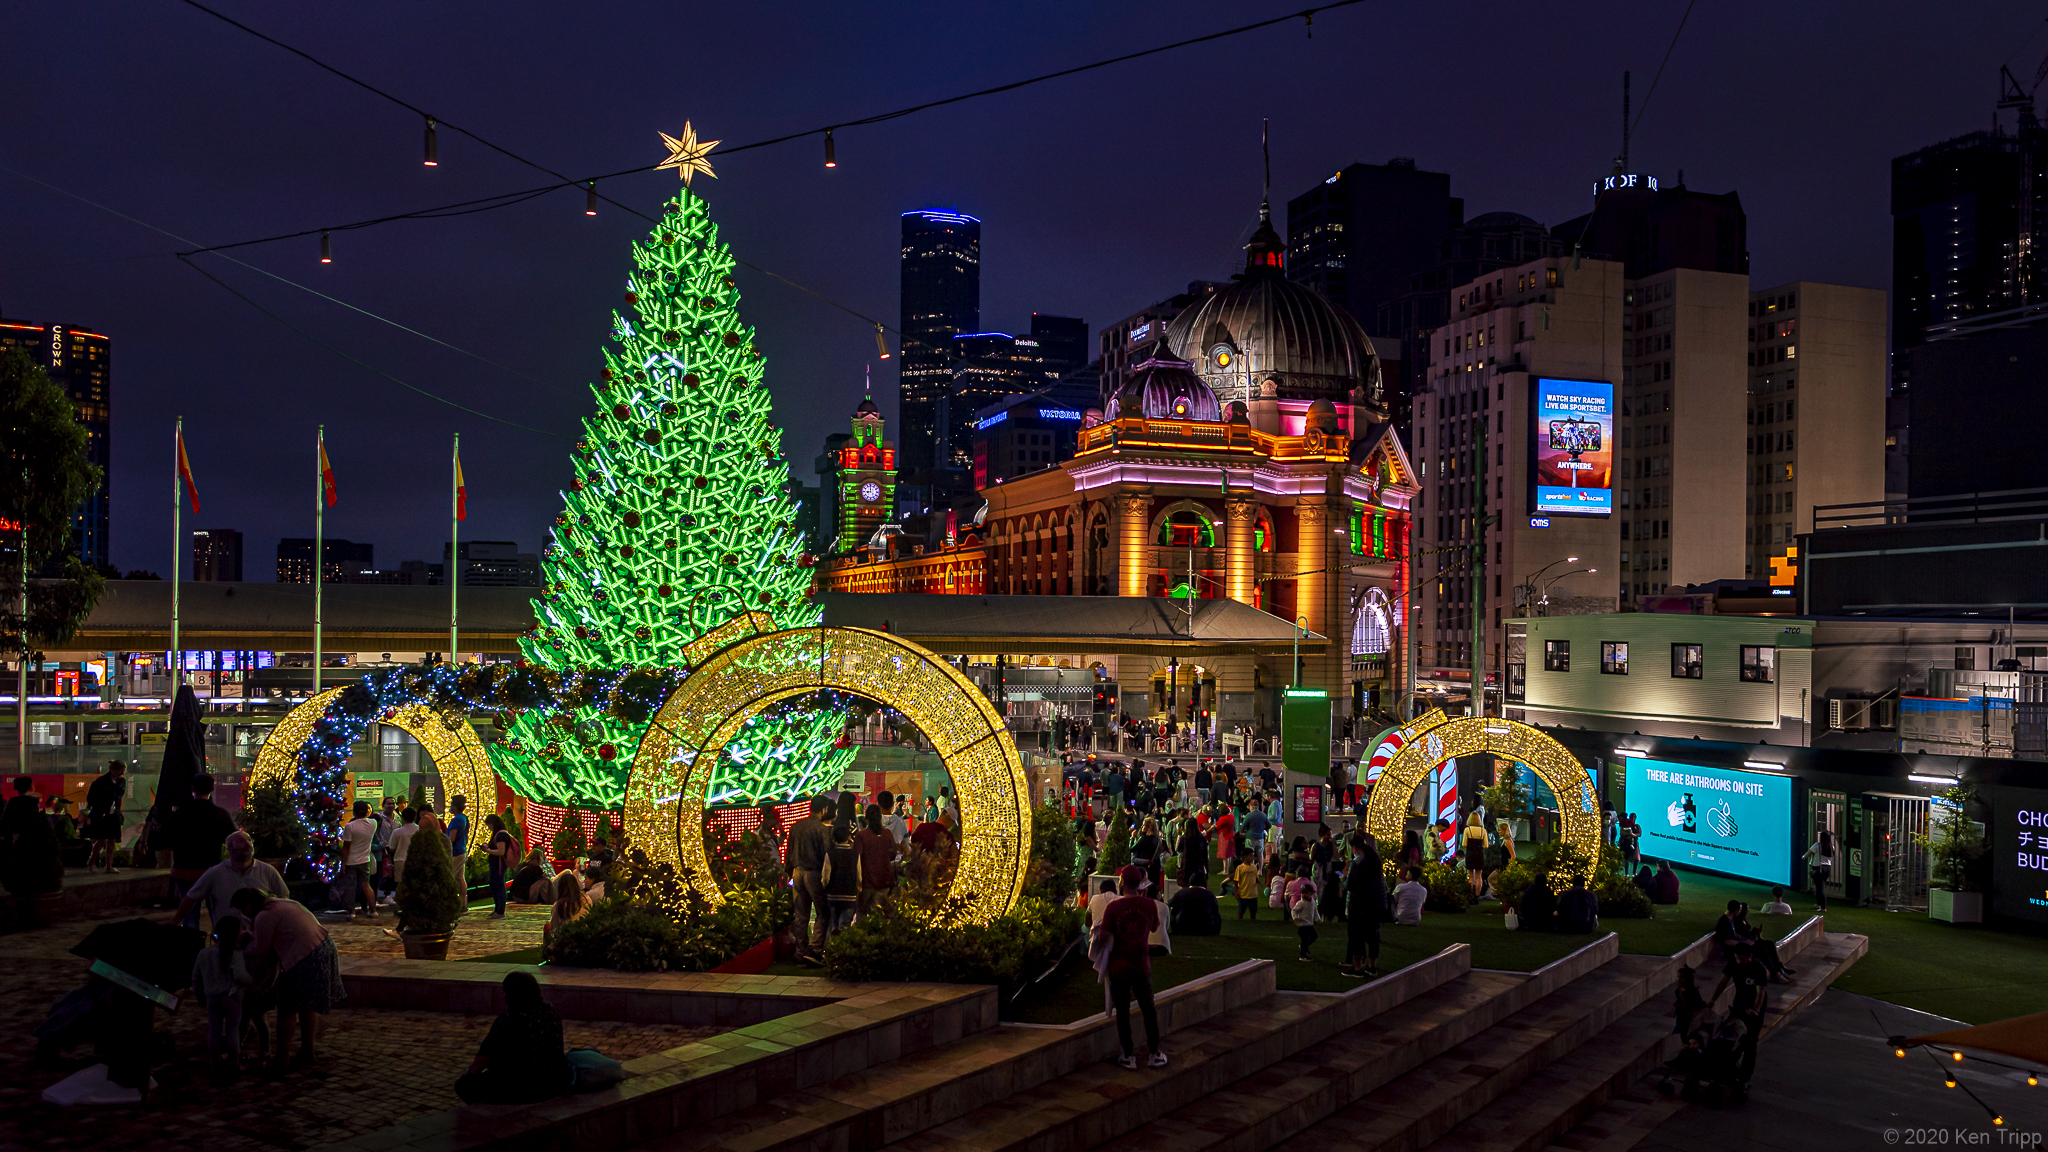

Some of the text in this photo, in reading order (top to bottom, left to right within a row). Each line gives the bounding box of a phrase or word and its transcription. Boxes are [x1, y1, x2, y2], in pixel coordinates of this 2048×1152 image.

[52, 325, 62, 367] CROWN
[1546, 394, 1568, 402] WATCH
[1582, 397, 1605, 405] RACING
[1040, 408, 1081, 420] VICTORIA
[1569, 404, 1606, 413] SPORTSBET.
[1557, 462, 1594, 470] ANYWHERE.
[198, 676, 205, 685] 8
[1646, 769, 1763, 796] THERE ARE BATHROOMS ON SITE
